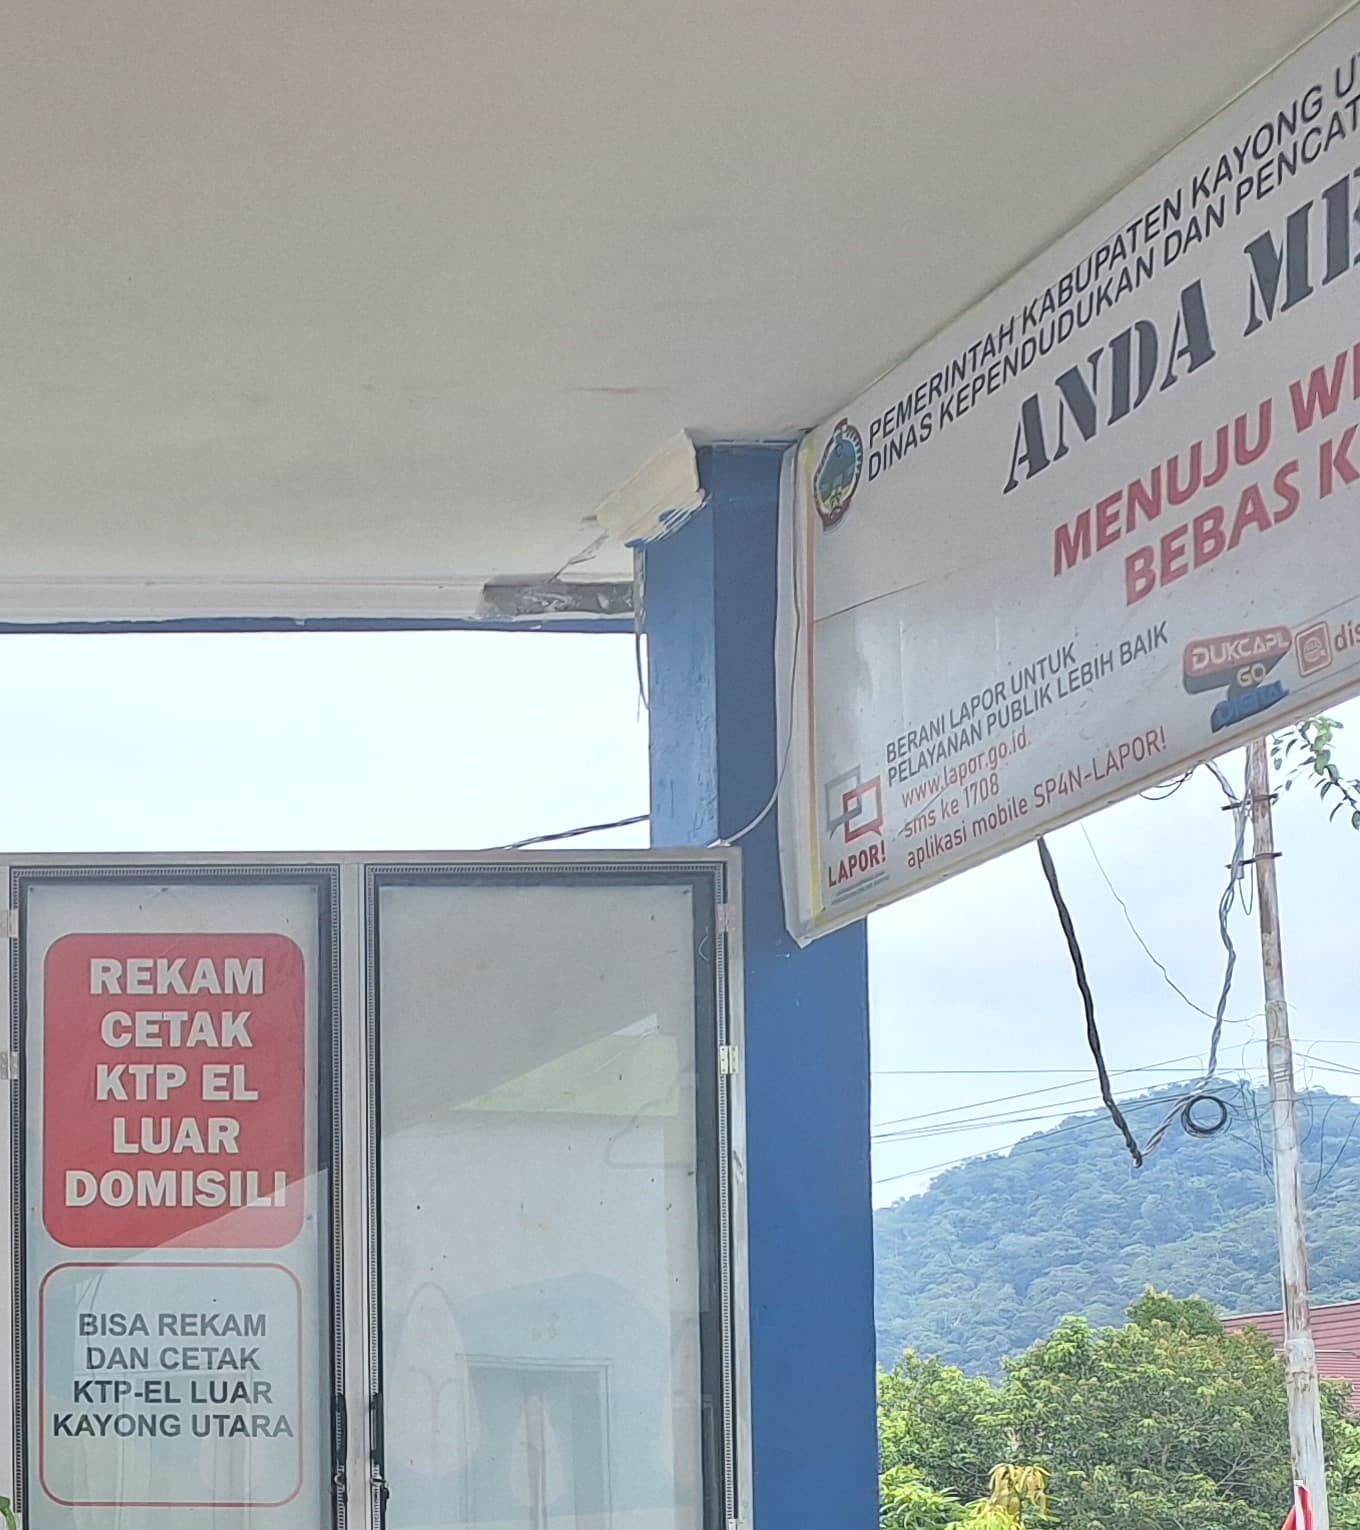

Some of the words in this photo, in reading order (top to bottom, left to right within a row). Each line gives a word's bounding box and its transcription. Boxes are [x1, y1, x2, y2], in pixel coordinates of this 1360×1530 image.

[868, 316, 1015, 446] PEMERINTAH
[1020, 188, 1183, 333] KABUPATEN
[1191, 84, 1323, 210] KAYONG
[867, 414, 932, 482] DINAS
[939, 255, 1154, 422] KEPENDUDUKAN
[1163, 198, 1226, 269] DAN
[1003, 278, 1216, 495] ANDA
[1052, 397, 1273, 578] MENUJU
[1125, 459, 1300, 606] BEBAS
[1237, 663, 1266, 688] GO
[885, 717, 947, 764] BERANI
[948, 681, 1007, 737] LAPOR
[1010, 641, 1078, 695] UNTUK
[887, 724, 982, 788] PELAYANAN
[986, 687, 1053, 743] PUBLIK
[1057, 655, 1115, 699] LEBIH
[1119, 620, 1169, 664] BAIK
[903, 812, 937, 839] sms
[941, 796, 961, 823] ke
[963, 777, 1000, 815] 1708
[907, 827, 967, 868] aplikasi
[972, 798, 1029, 844] mobile
[1032, 725, 1168, 809] SP4N-LAPOR!
[828, 839, 886, 888] LAPOR!
[89, 957, 264, 995] REKAM
[100, 1011, 254, 1048] CETAK
[96, 1064, 187, 1101] KTP
[201, 1064, 259, 1101] EL
[113, 1117, 240, 1154] LUAR
[64, 1170, 287, 1208] DOMISILI
[79, 1313, 150, 1337] BISA
[158, 1313, 267, 1337] REKAM
[73, 1380, 181, 1404] KTP-EL
[191, 1380, 273, 1404] LUAR
[53, 1414, 181, 1437] KAYONG
[192, 1414, 294, 1437] UTARA
